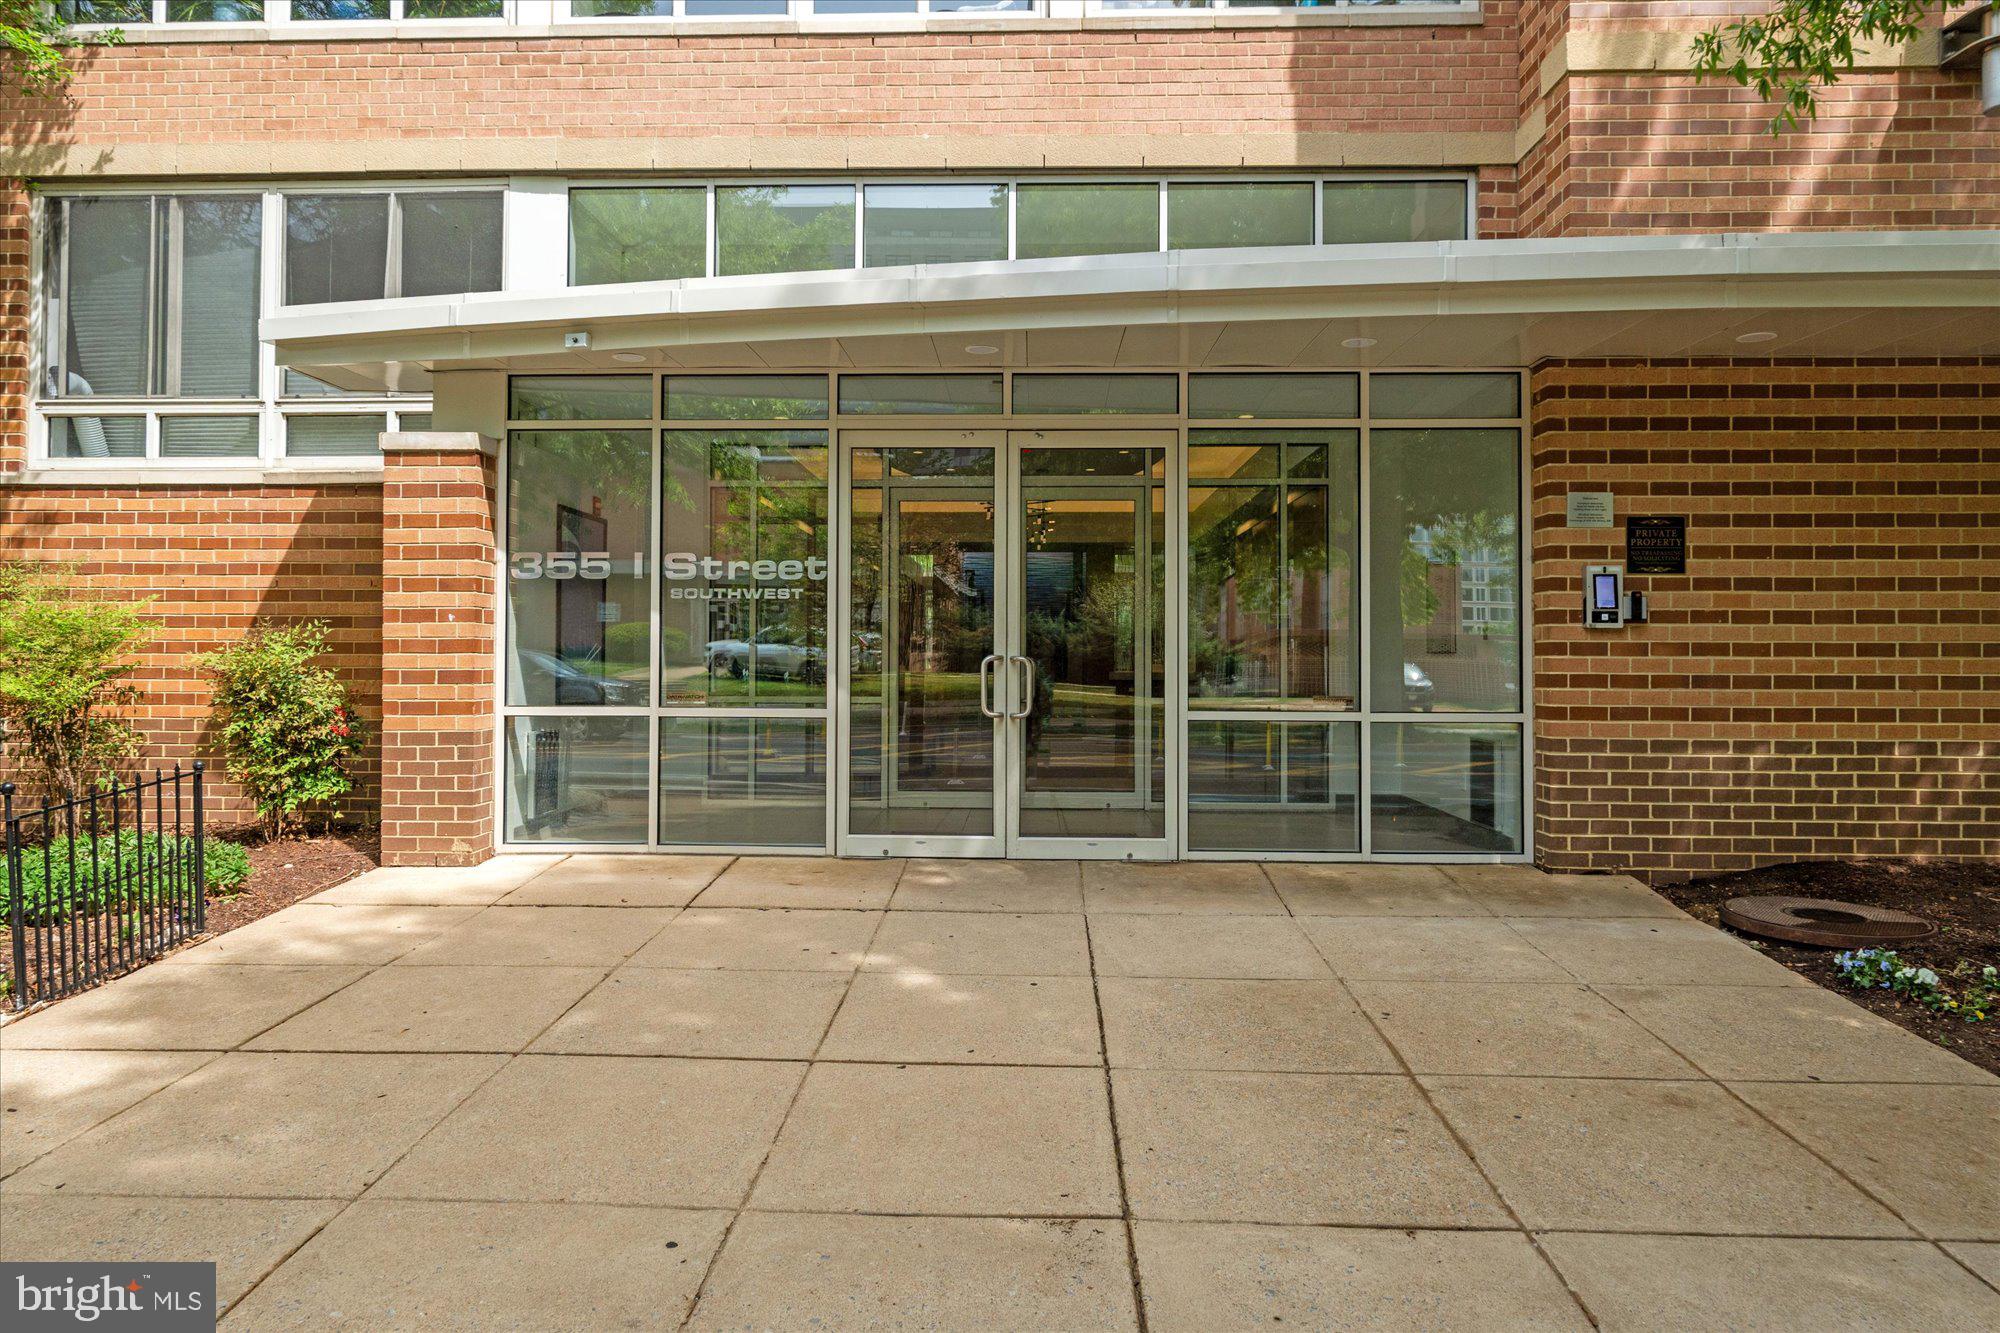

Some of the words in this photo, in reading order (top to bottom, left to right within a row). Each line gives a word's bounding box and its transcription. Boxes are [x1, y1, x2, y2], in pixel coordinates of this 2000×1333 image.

[1635, 529, 1678, 538] PRIVATE
[1630, 538, 1682, 547] PROPERTY
[510, 551, 611, 580] 355
[664, 551, 828, 581] Street
[669, 587, 804, 600] SOUTHWEST
